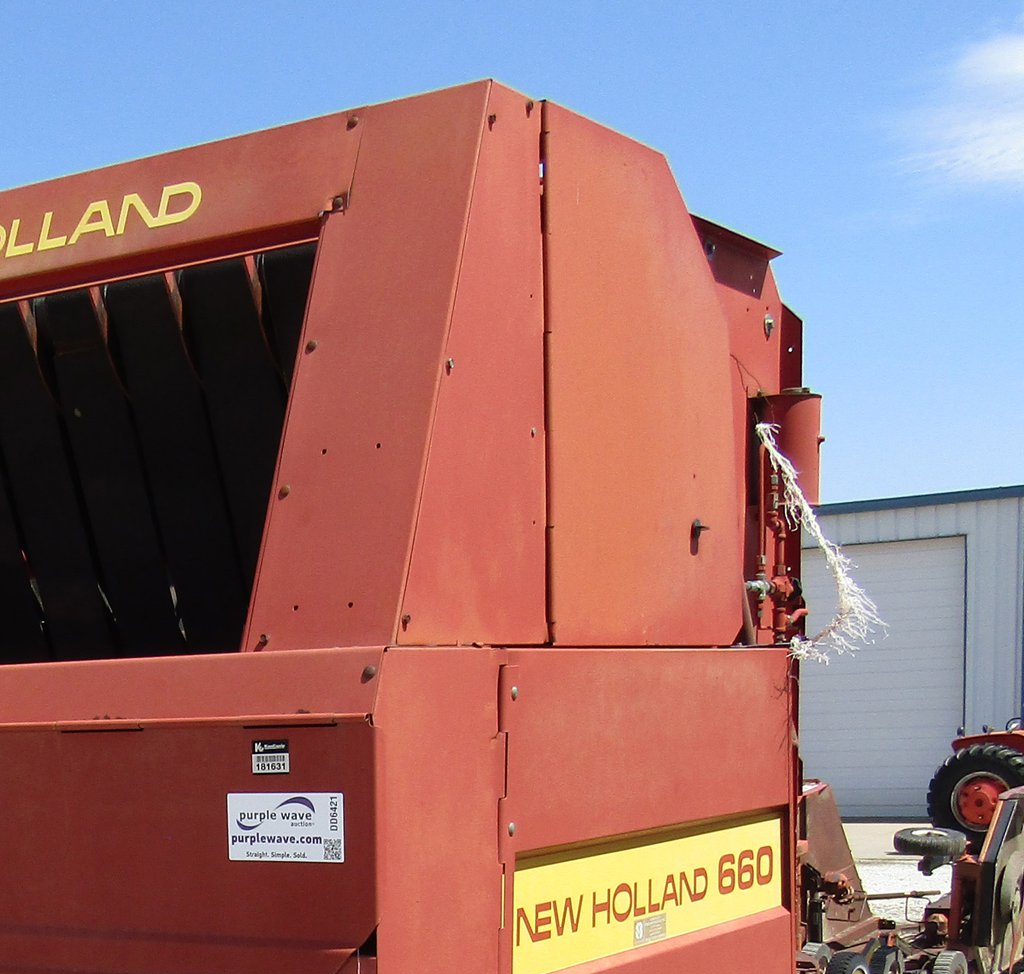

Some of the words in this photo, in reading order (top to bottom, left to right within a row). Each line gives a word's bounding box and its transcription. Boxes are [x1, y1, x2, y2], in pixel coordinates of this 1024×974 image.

[256, 762, 286, 771] 181631
[239, 810, 277, 823] purple
[281, 812, 312, 821] wave
[329, 796, 338, 832] DD6421
[231, 833, 322, 846] purplewave.com
[246, 851, 269, 859] Straight.
[271, 851, 292, 860] Simple.
[516, 894, 584, 946] NEW
[592, 867, 708, 928] HOLLAND
[718, 845, 773, 895] 660
